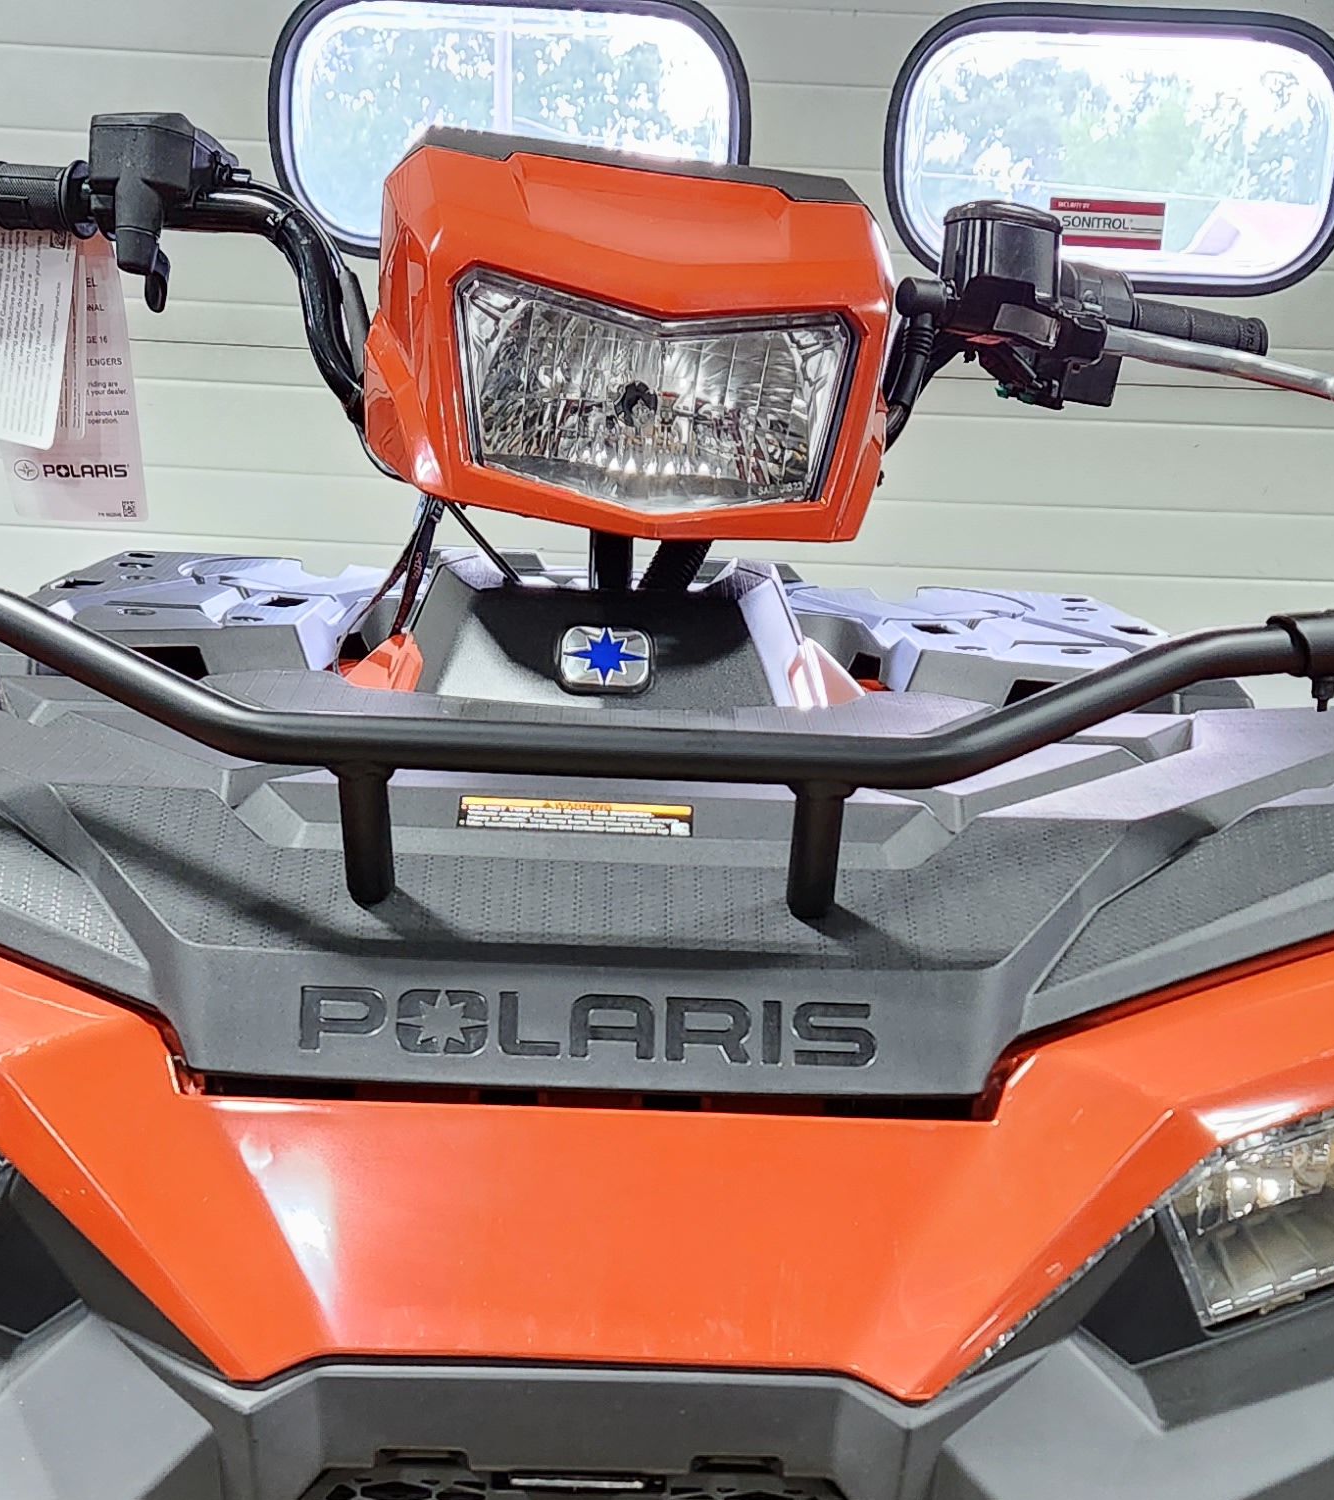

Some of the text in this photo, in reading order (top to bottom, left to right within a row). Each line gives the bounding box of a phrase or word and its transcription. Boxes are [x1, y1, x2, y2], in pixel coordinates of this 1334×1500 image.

[1061, 215, 1129, 230] SONITROL
[99, 335, 108, 344] 16
[42, 464, 128, 478] POLARIS
[298, 984, 879, 1067] POLARIS
